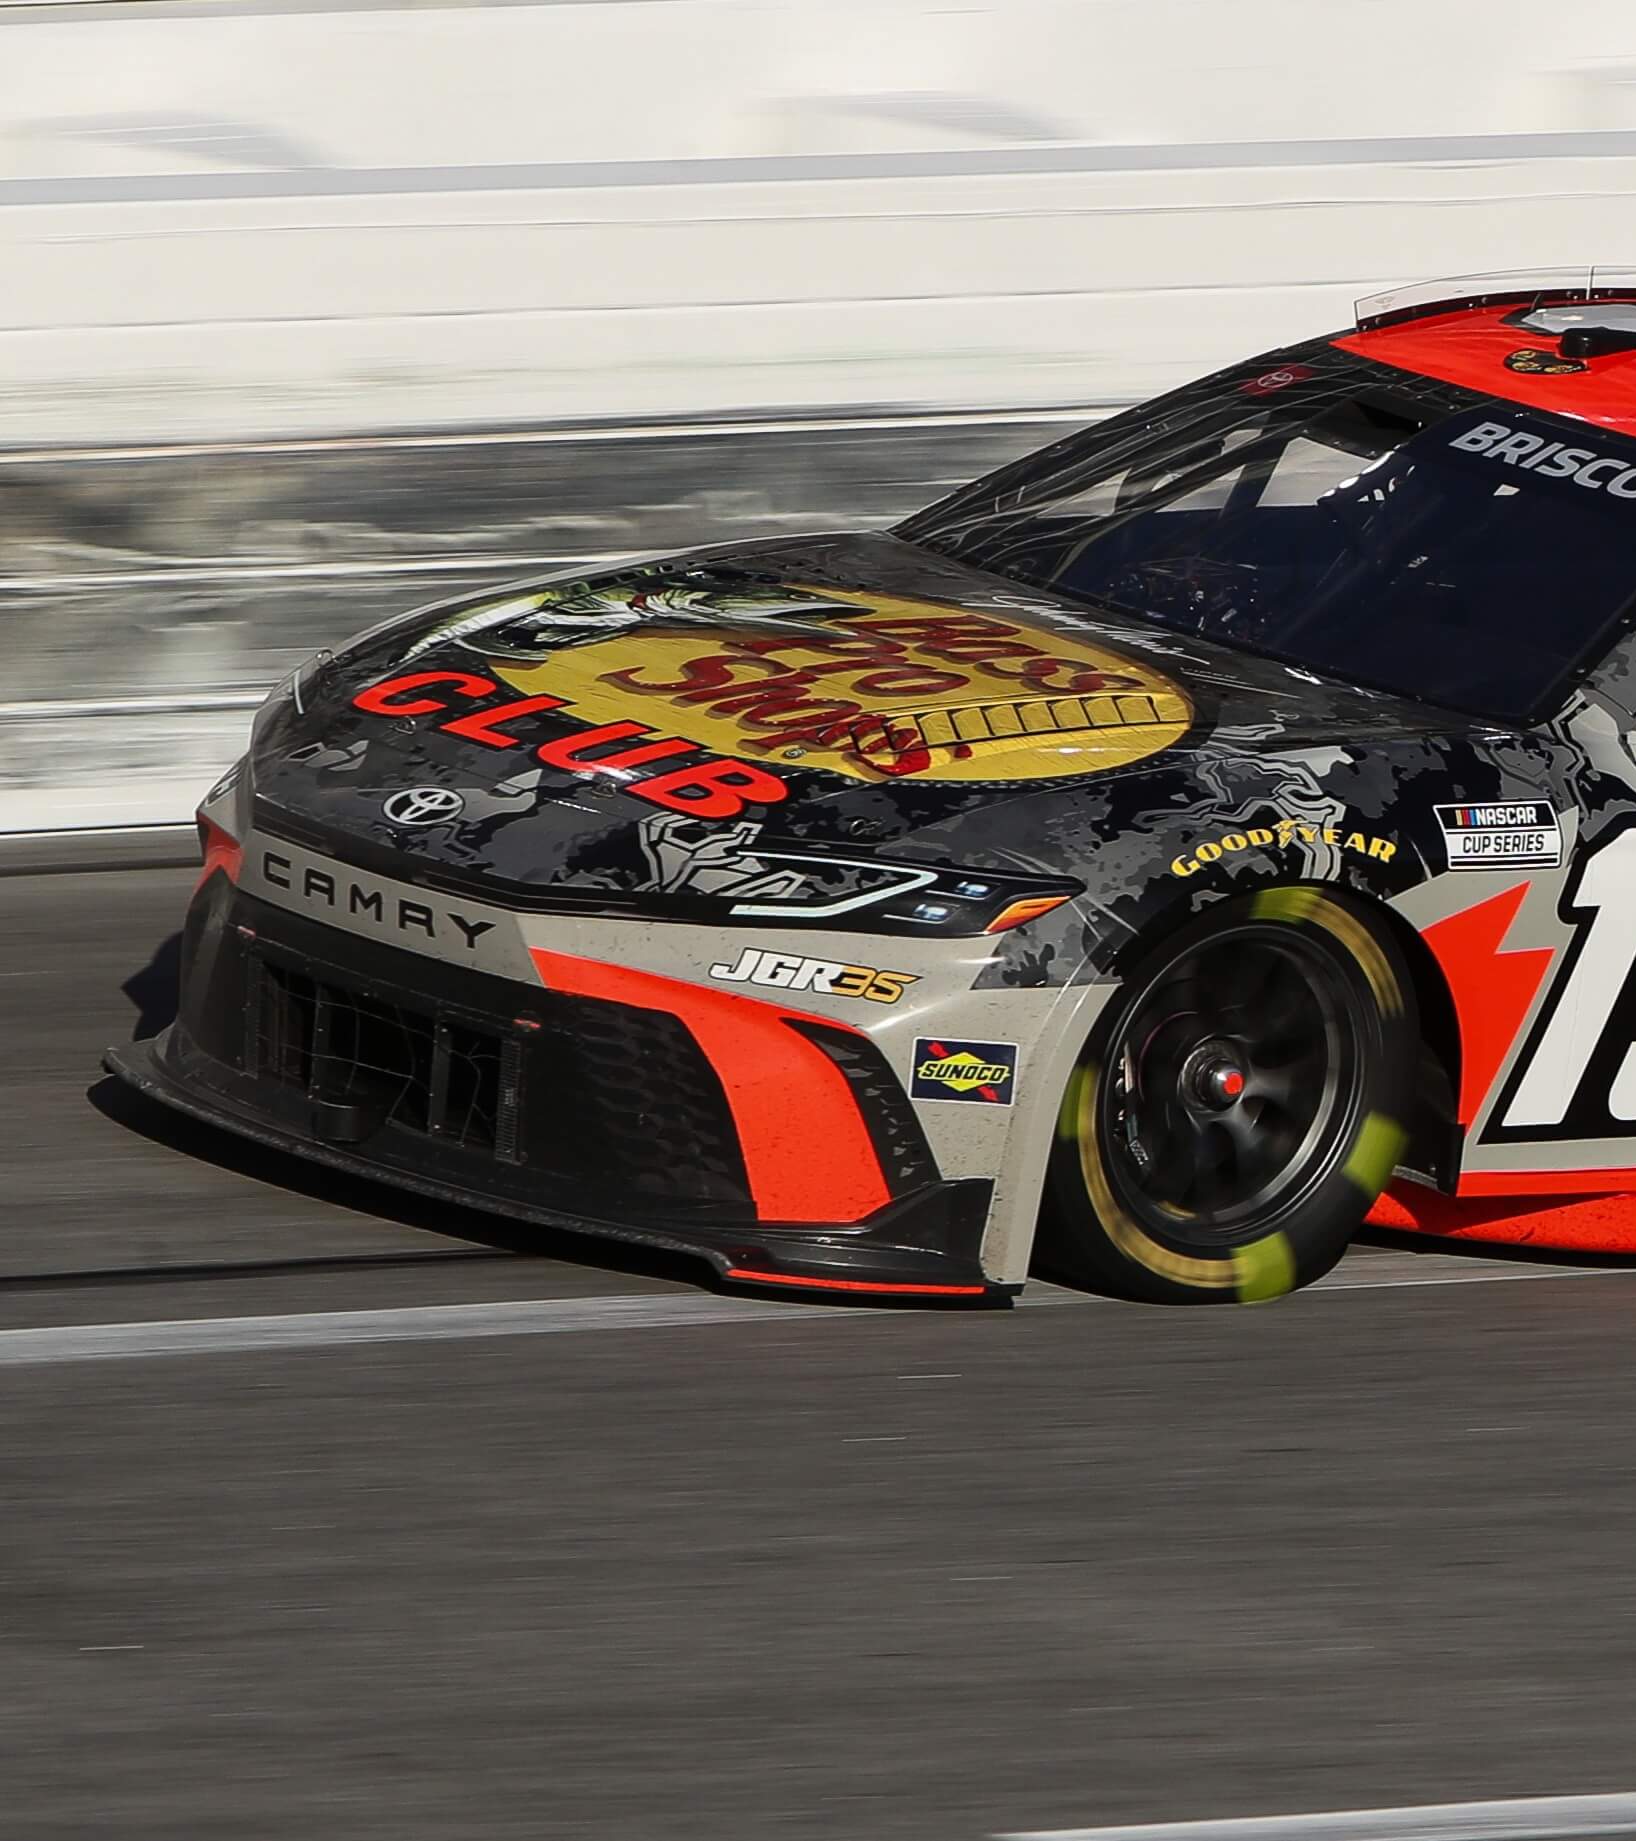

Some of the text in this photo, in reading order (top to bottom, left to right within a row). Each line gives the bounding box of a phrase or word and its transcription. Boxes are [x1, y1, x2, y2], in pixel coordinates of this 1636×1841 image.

[724, 633, 971, 696] Pro
[836, 613, 1146, 693] Bass
[352, 671, 789, 818] CLUB
[1462, 833, 1545, 854] CUP SERIES
[1476, 807, 1538, 825] NASCAR
[1170, 827, 1397, 877] GOODYEAR
[263, 850, 496, 949] CAMRY
[921, 1062, 1007, 1083] SUNOCO
